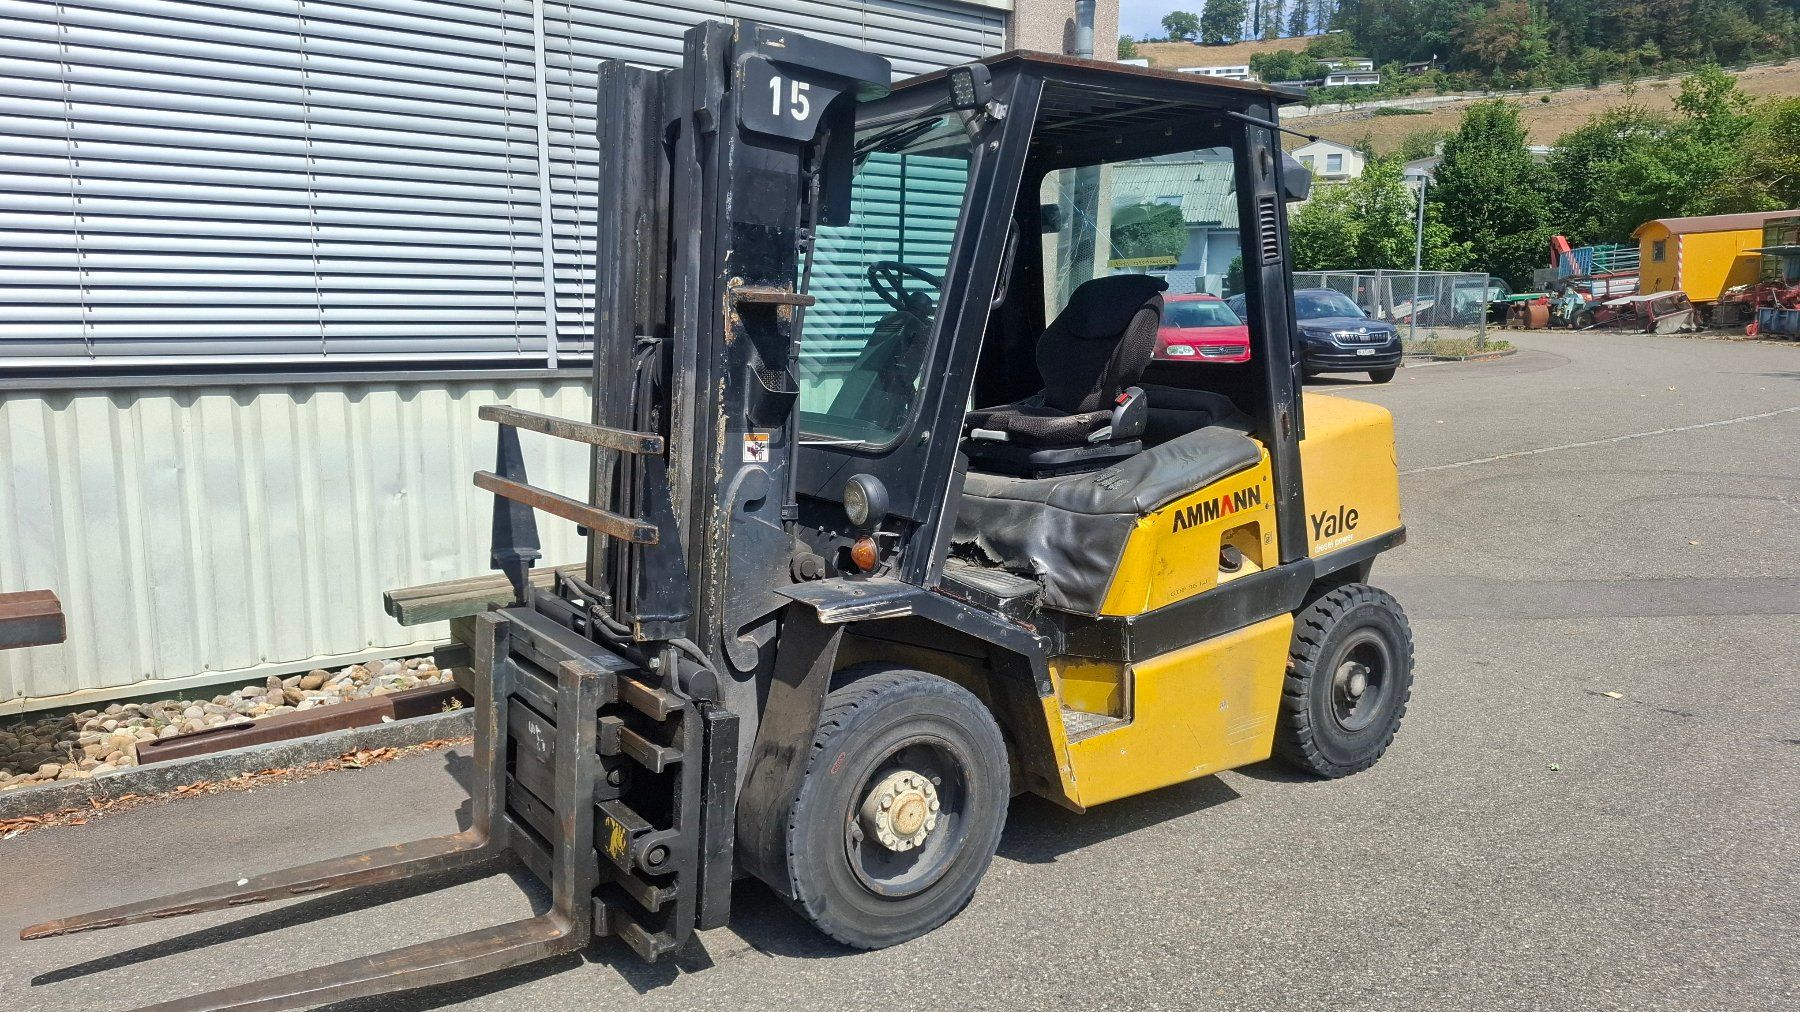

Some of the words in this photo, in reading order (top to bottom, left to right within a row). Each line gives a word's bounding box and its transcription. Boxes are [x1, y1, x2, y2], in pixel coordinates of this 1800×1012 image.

[769, 76, 810, 120] 15
[1172, 484, 1261, 533] AMMANN
[1310, 505, 1359, 541] Yale
